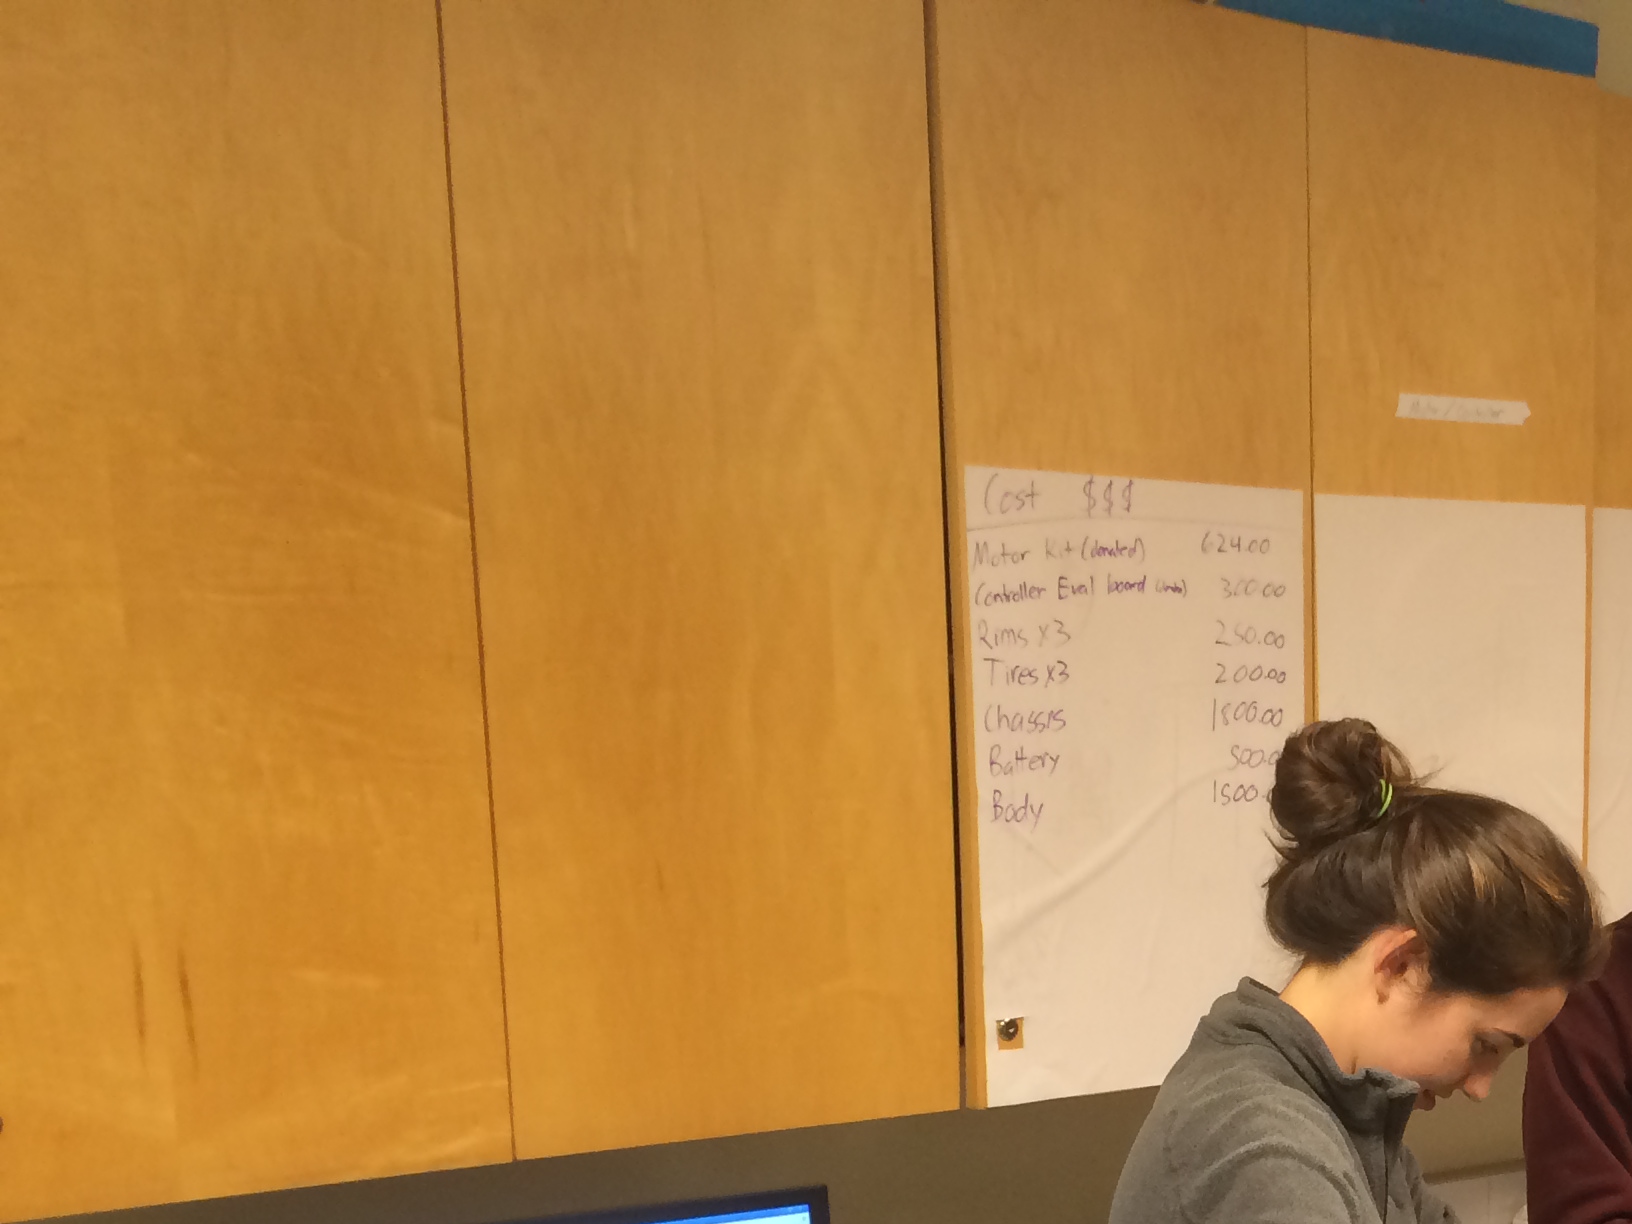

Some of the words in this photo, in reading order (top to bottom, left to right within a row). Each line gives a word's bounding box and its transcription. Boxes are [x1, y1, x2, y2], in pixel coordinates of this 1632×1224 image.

[984, 473, 1040, 515] Cost
[972, 541, 1031, 572] Motor
[1201, 531, 1271, 555] 624.00
[975, 581, 1046, 607] Controller
[1057, 575, 1095, 601] Eval
[1107, 573, 1147, 595] board
[977, 619, 1029, 651] Rims
[1214, 619, 1286, 650] 250.00
[983, 657, 1039, 687] Tires
[1214, 662, 1287, 685] 200.00
[983, 703, 1067, 735] Chassis
[1212, 698, 1284, 732] 1800.00
[989, 744, 1061, 778] Battery
[1227, 744, 1280, 771] 500.0
[991, 789, 1044, 834] Body
